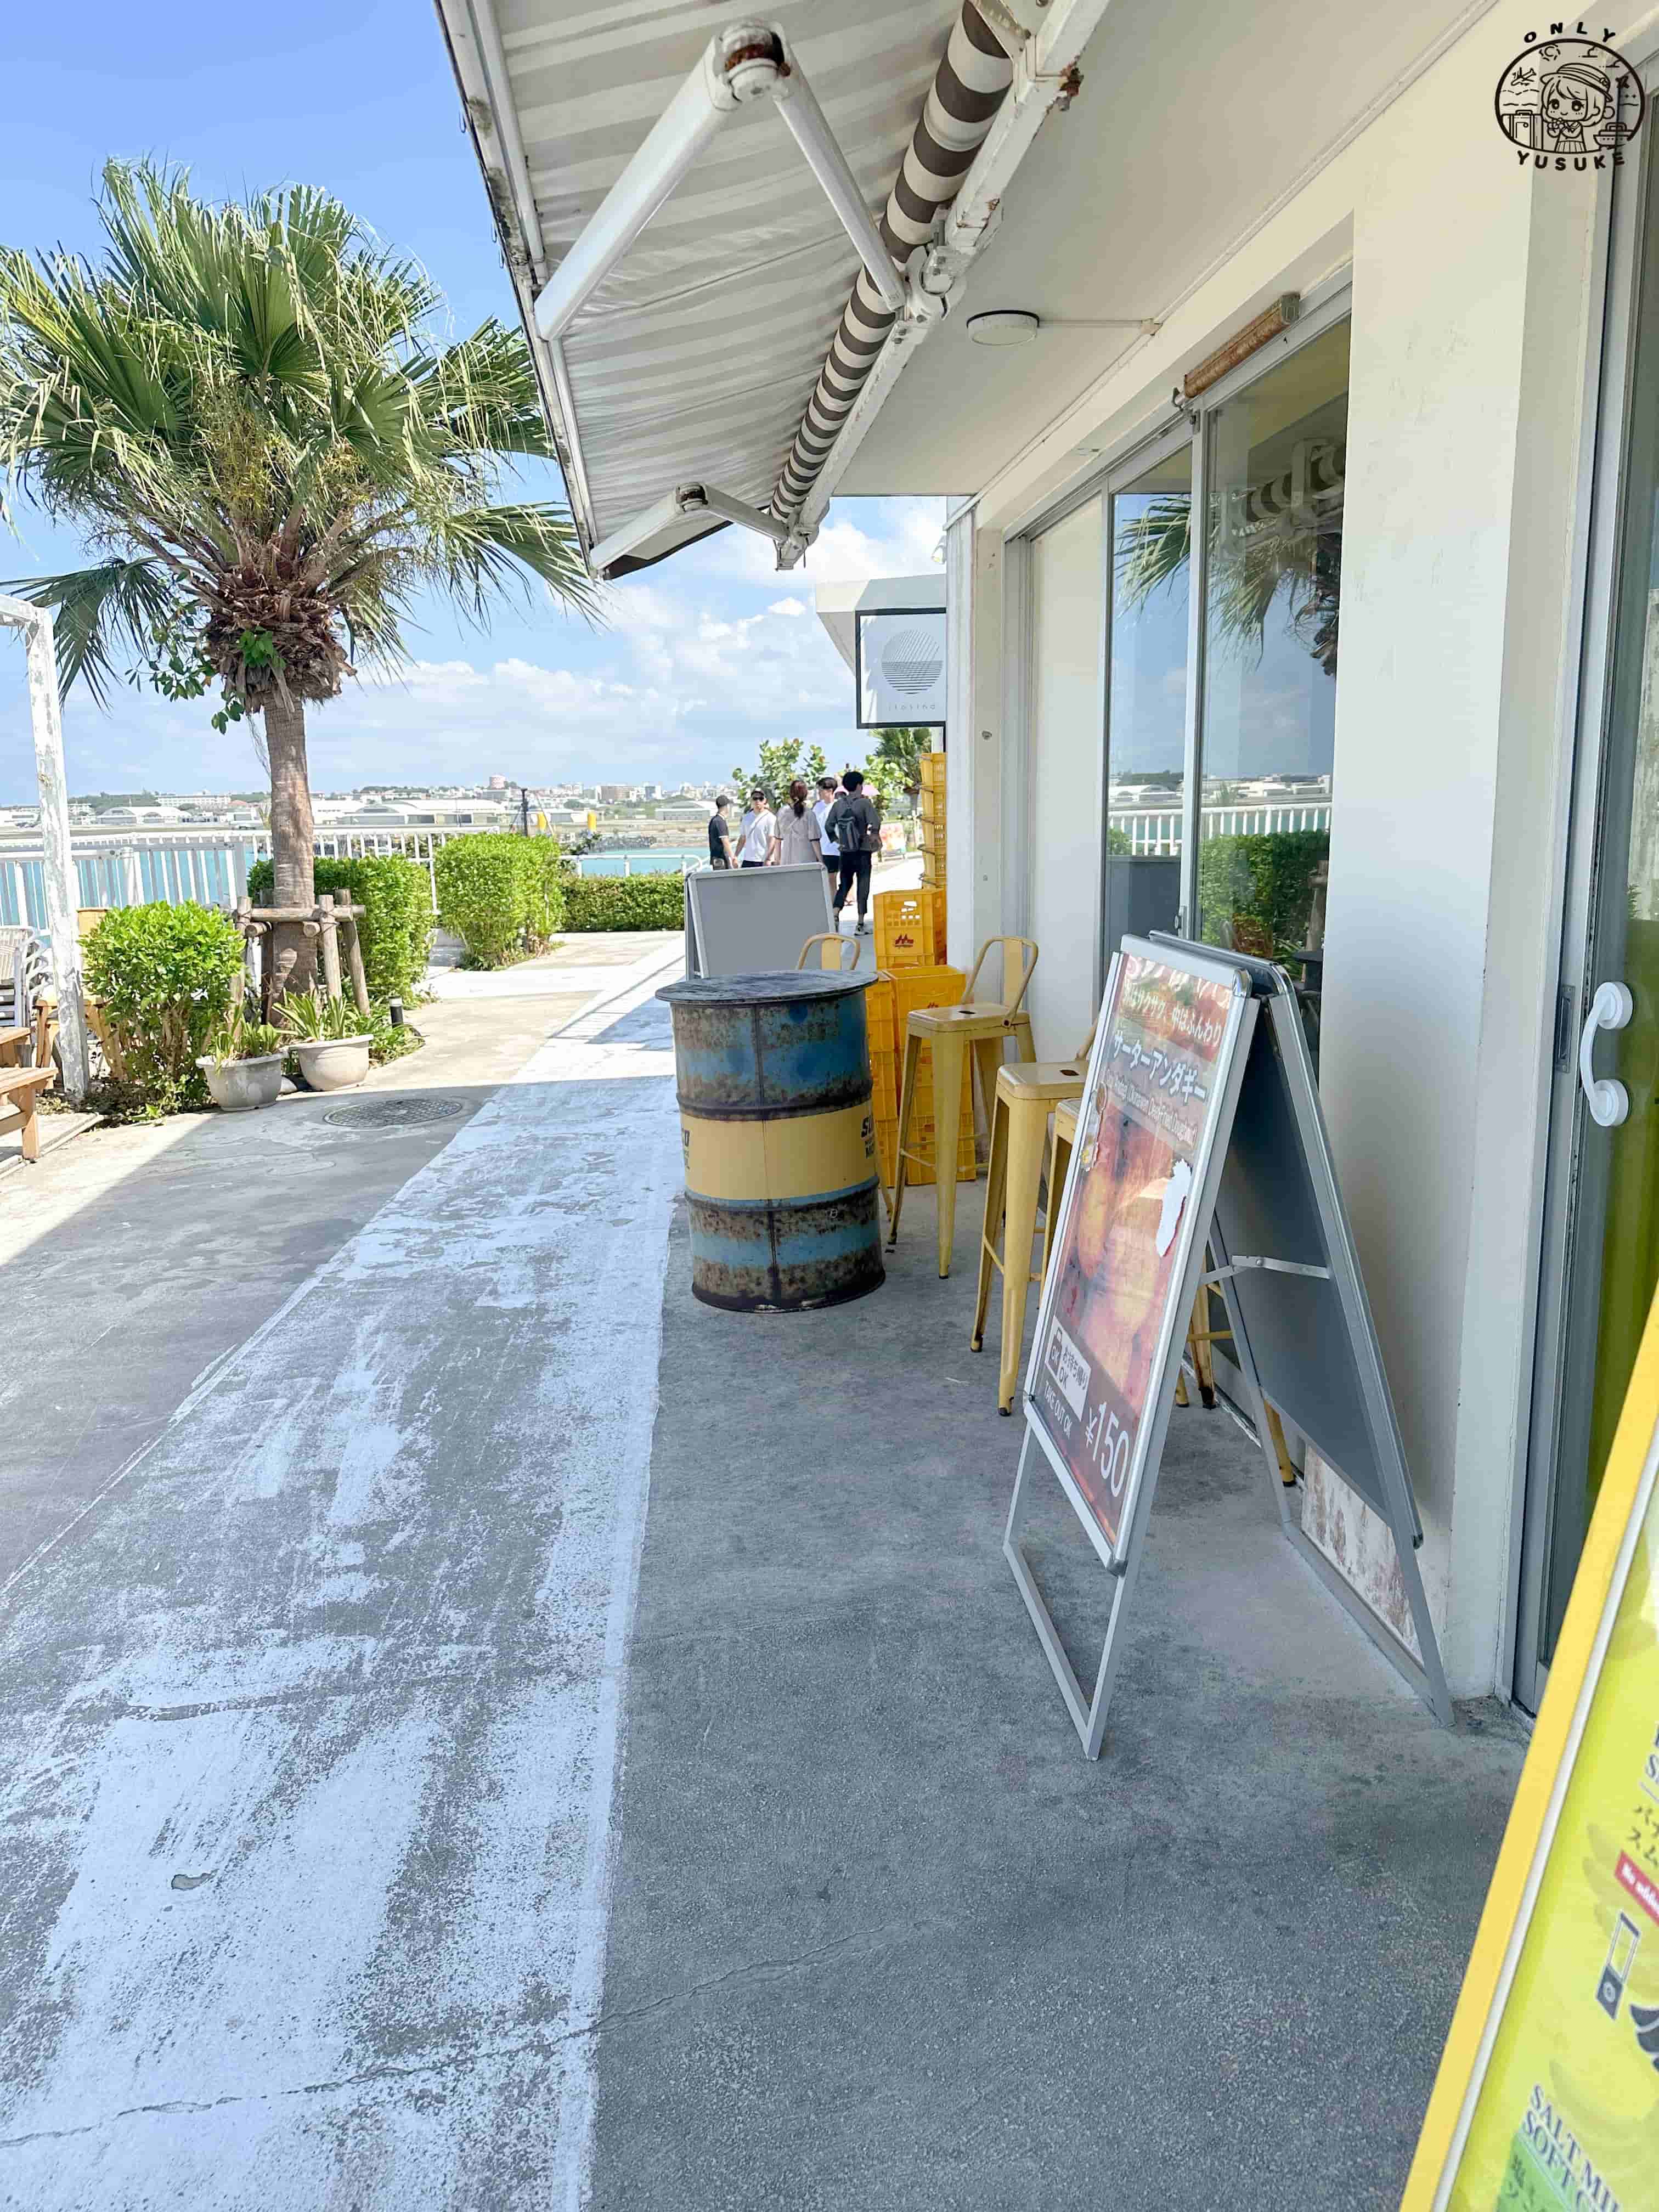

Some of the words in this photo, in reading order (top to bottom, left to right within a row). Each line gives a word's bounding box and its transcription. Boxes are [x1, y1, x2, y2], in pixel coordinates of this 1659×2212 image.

[1114, 1029, 1206, 1103] サーターアンダギー
[1045, 1380, 1056, 1409] TAKE
[1054, 1400, 1065, 1427] OUT
[1064, 1414, 1073, 1440] OK
[1059, 1367, 1069, 1390] OK
[1085, 1401, 1129, 1498] ¥150
[1521, 2111, 1576, 2189] SOFT
[1530, 2084, 1583, 2162] SALT
